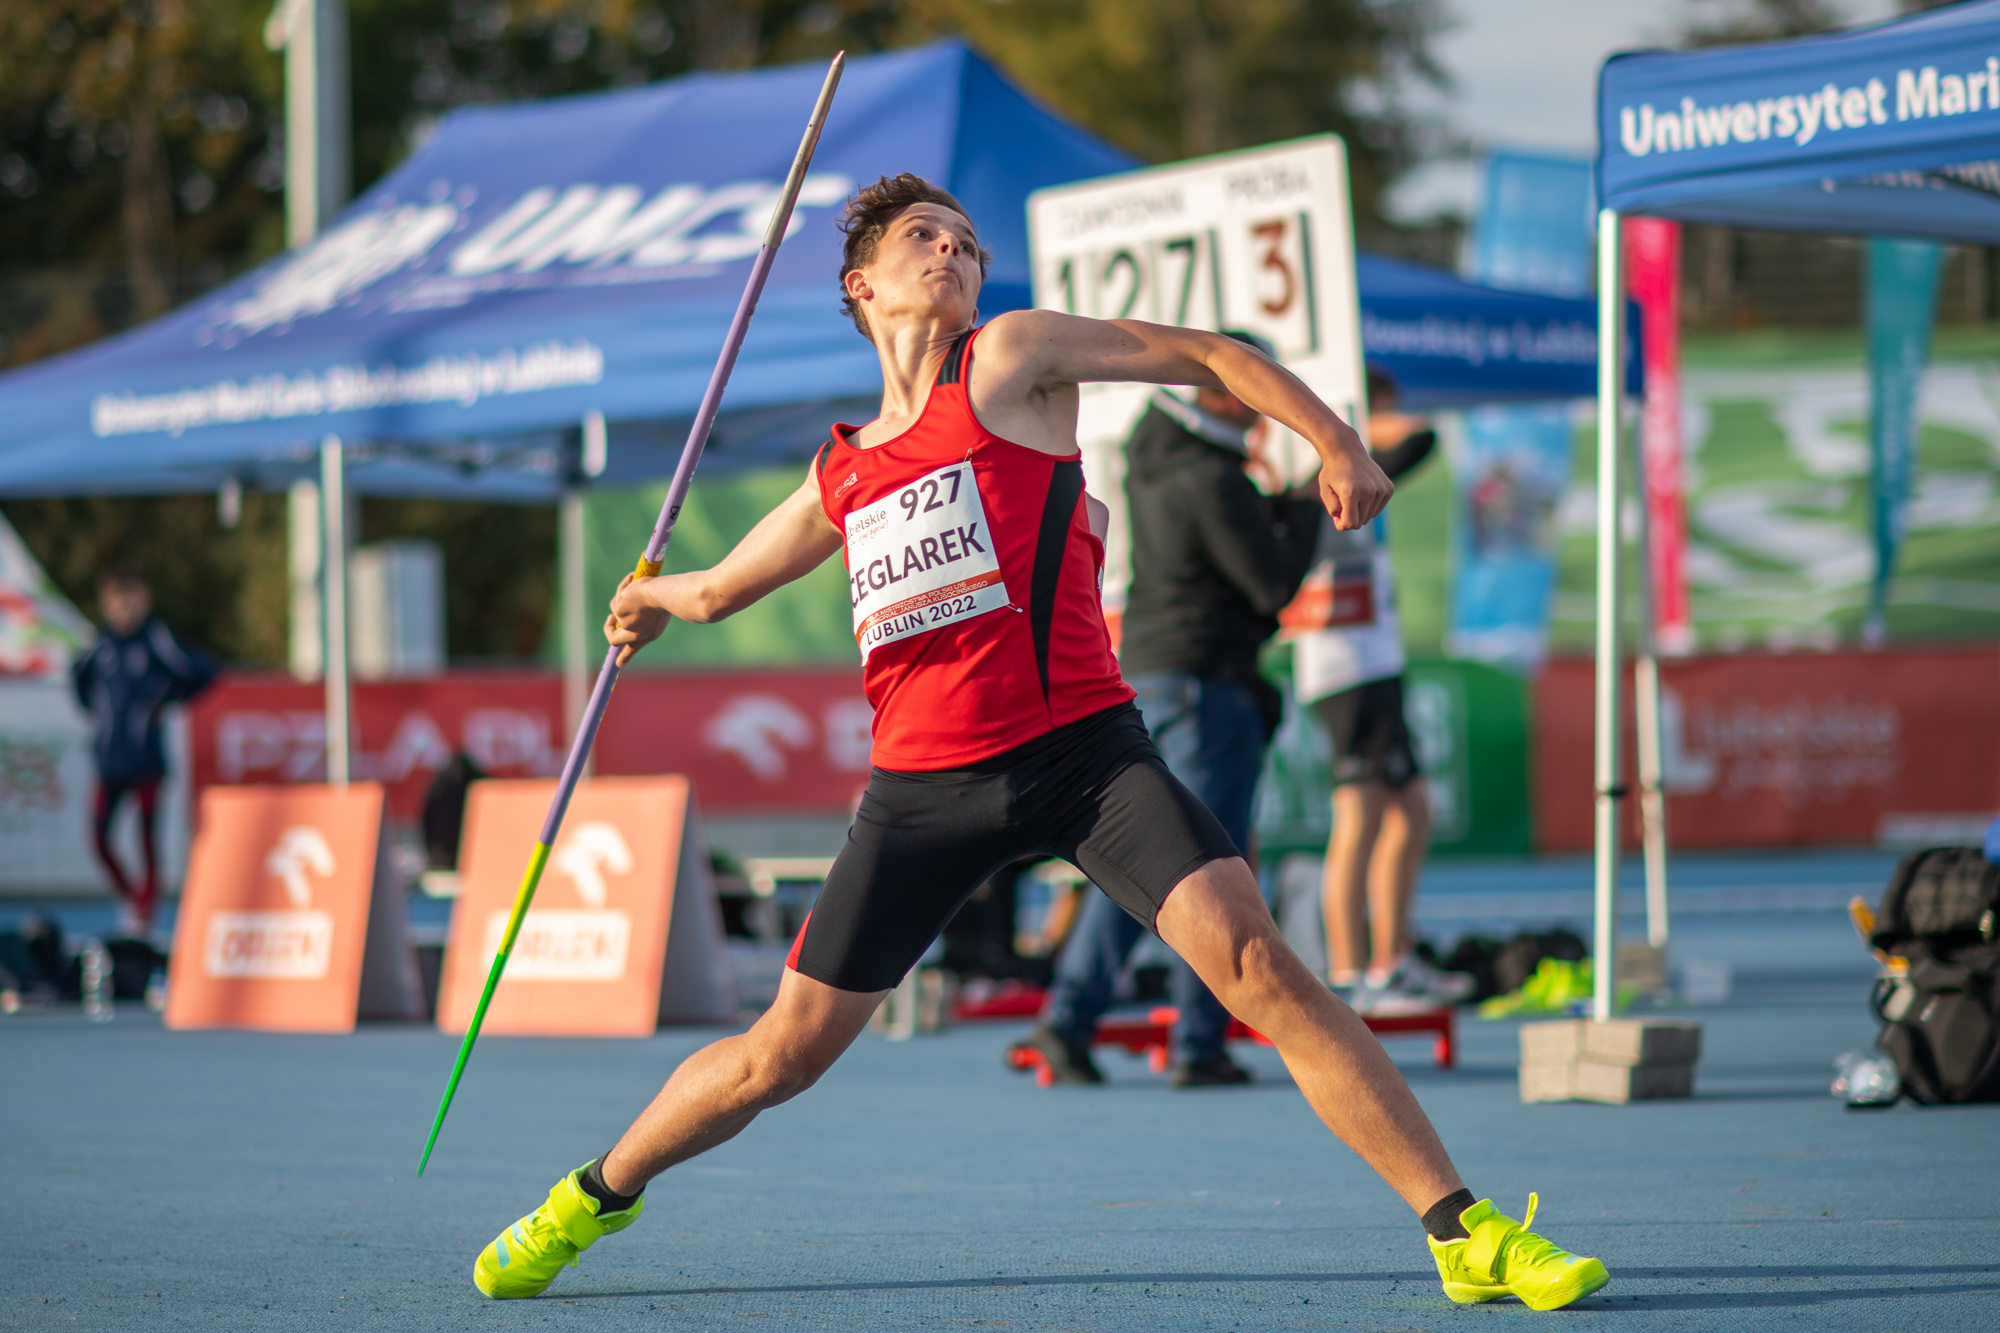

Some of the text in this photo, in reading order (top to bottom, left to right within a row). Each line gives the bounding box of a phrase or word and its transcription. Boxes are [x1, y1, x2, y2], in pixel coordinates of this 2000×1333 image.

[1620, 56, 2000, 157] Uniwersytet Mari
[1251, 219, 1294, 318] 3
[899, 469, 962, 522] 927
[851, 522, 987, 609] CEGLAREK
[928, 586, 954, 598] POLSKI
[866, 594, 977, 646] LUBLIN 2022
